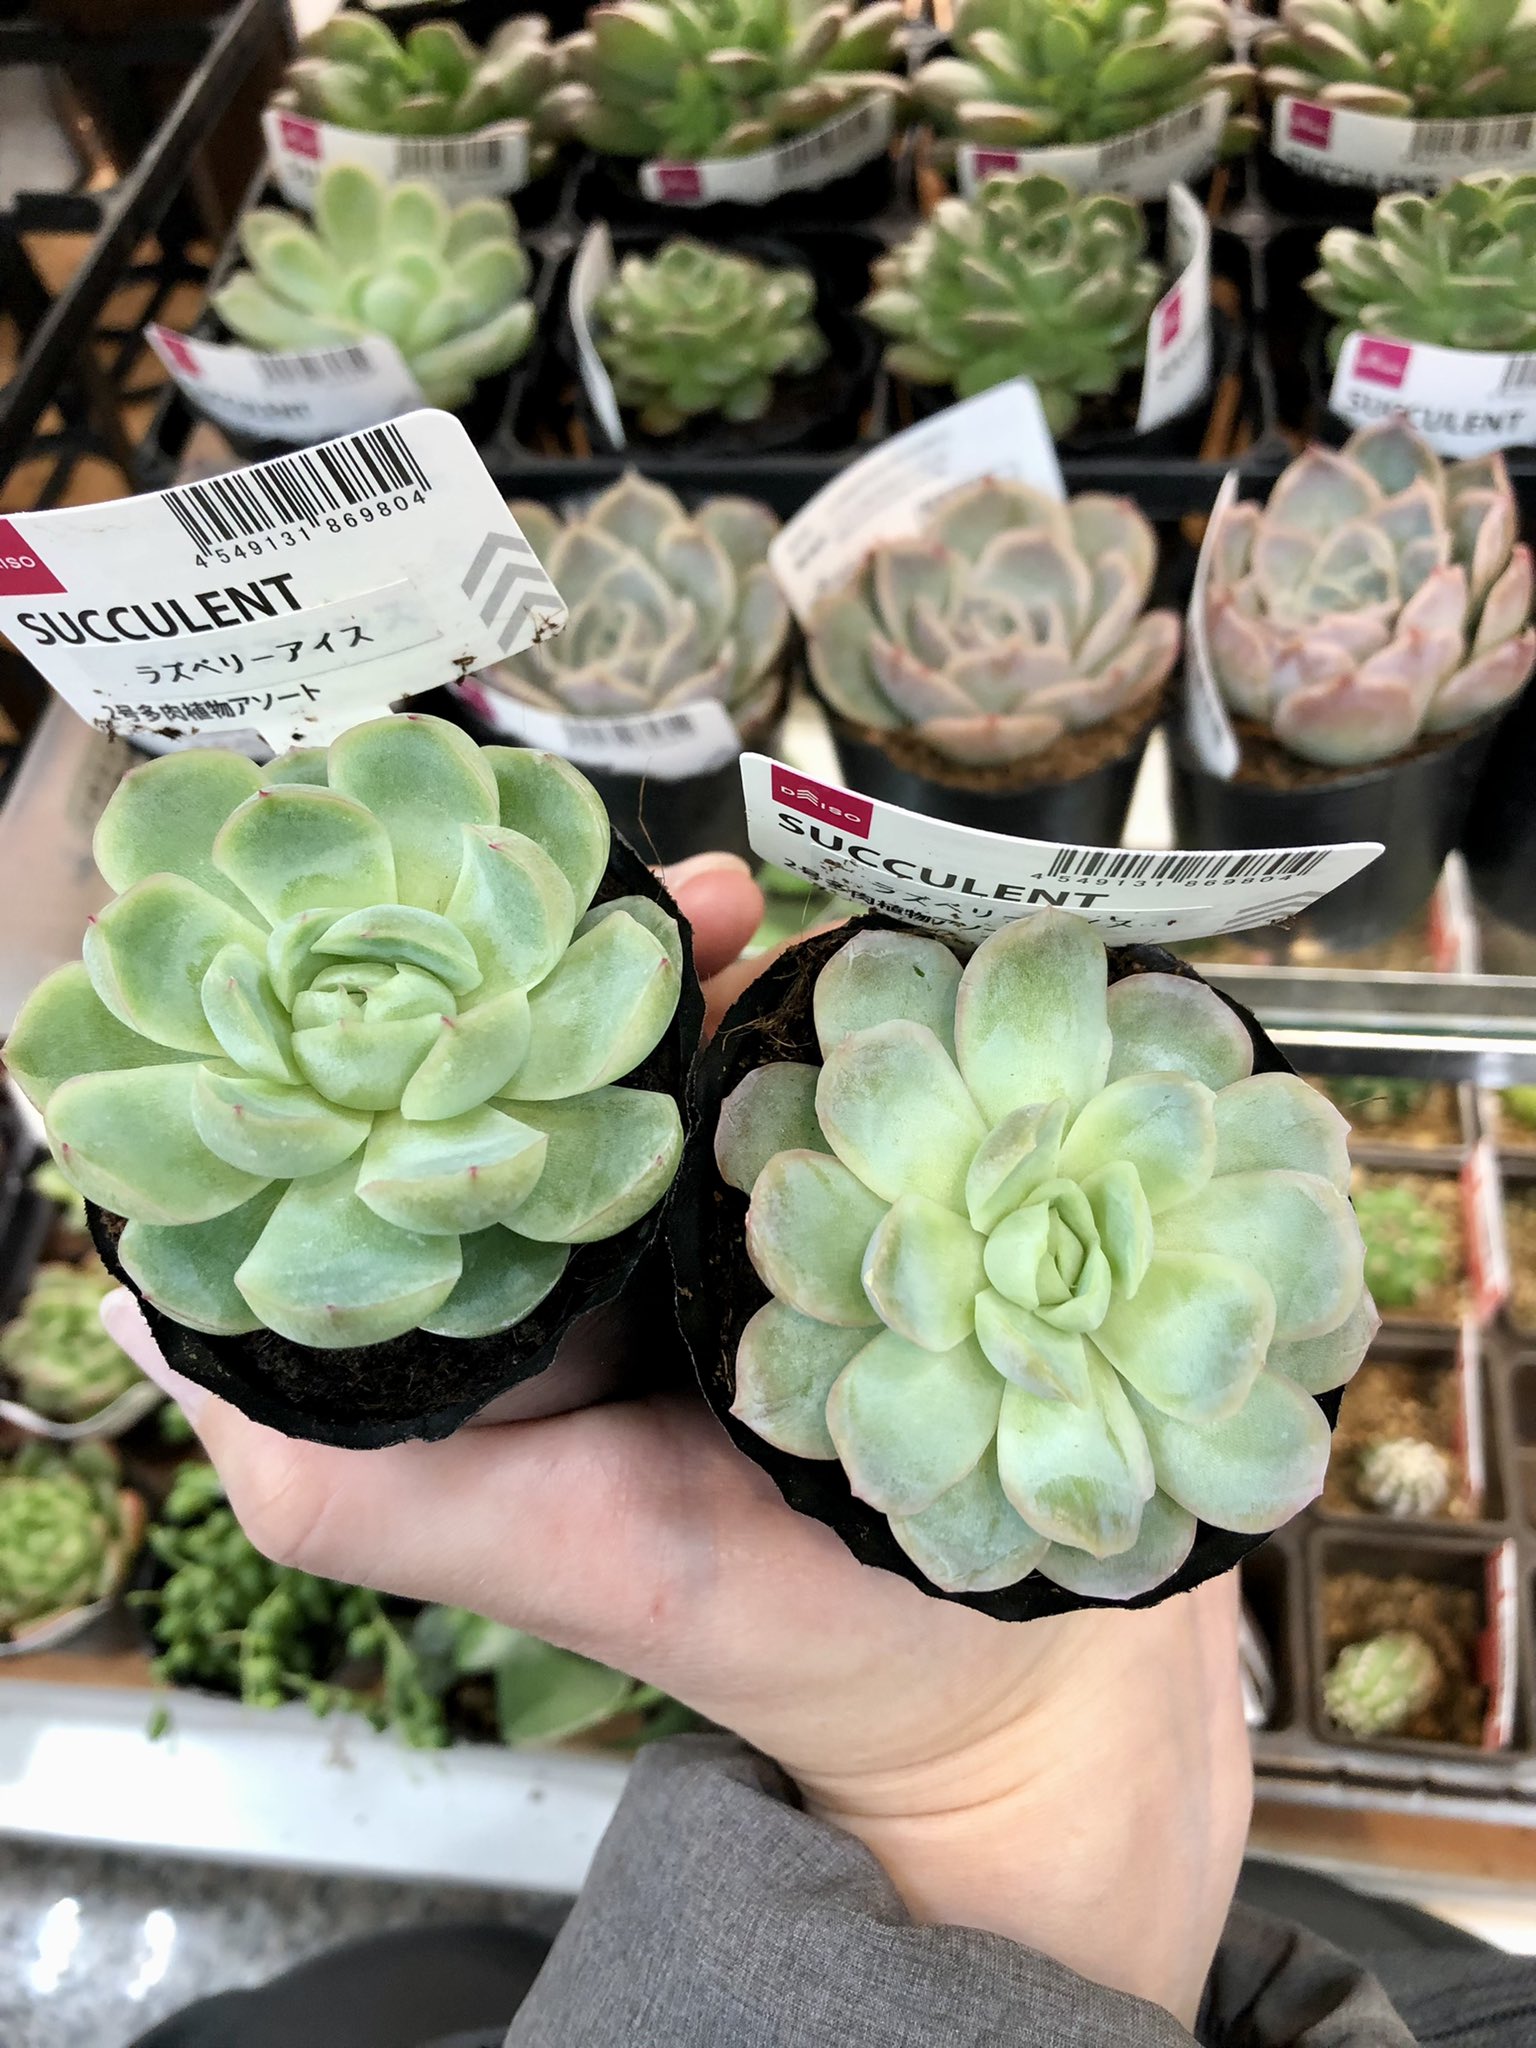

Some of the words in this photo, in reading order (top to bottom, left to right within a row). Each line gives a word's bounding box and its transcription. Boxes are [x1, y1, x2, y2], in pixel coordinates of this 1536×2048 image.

[0, 556, 36, 569] ISO
[16, 573, 302, 645] SUCCULENT
[135, 625, 375, 684] ラズベリーアイス
[102, 683, 321, 723] 2号多肉植物アソート
[778, 813, 1110, 908] SUCCULENT
